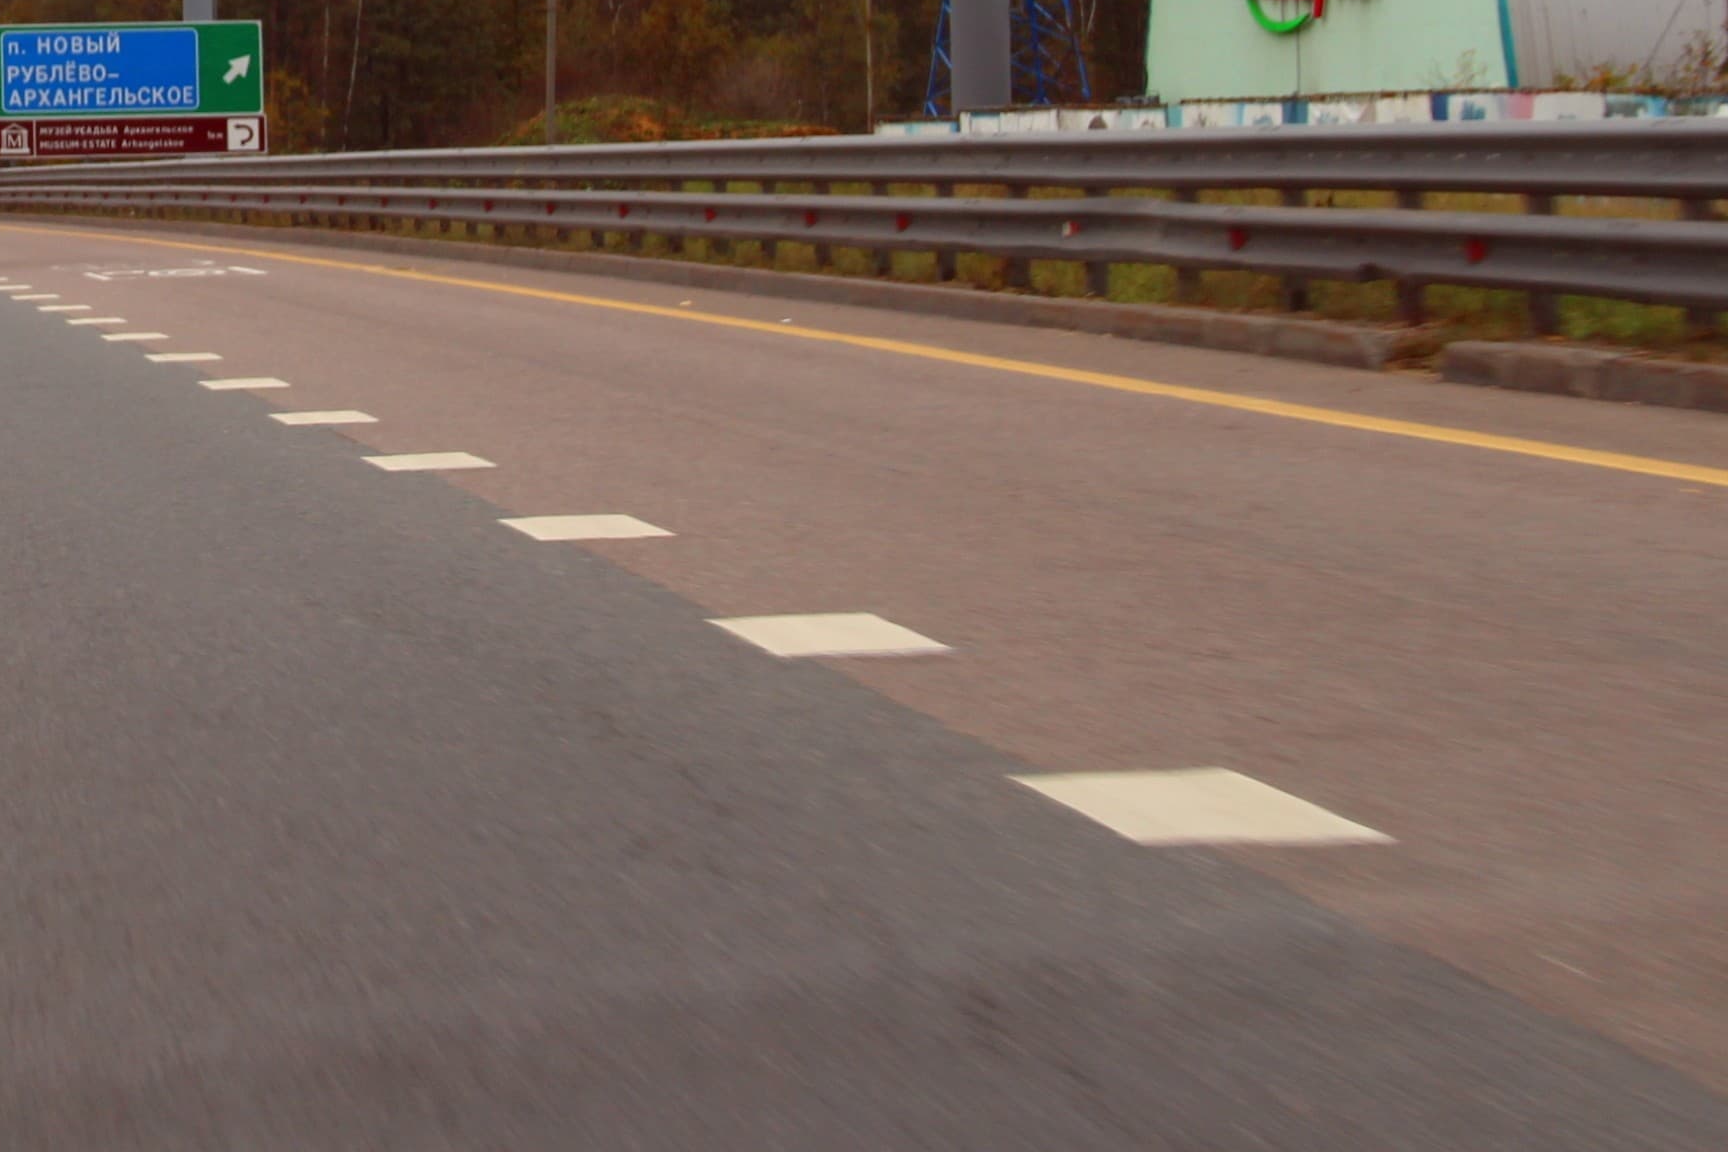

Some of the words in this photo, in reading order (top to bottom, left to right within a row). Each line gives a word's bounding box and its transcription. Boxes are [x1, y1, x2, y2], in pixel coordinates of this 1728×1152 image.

[8, 41, 26, 55] п.
[37, 32, 120, 55] НОВЫЙ
[9, 86, 194, 108] АРХАНГЕЛЬСКОЕ
